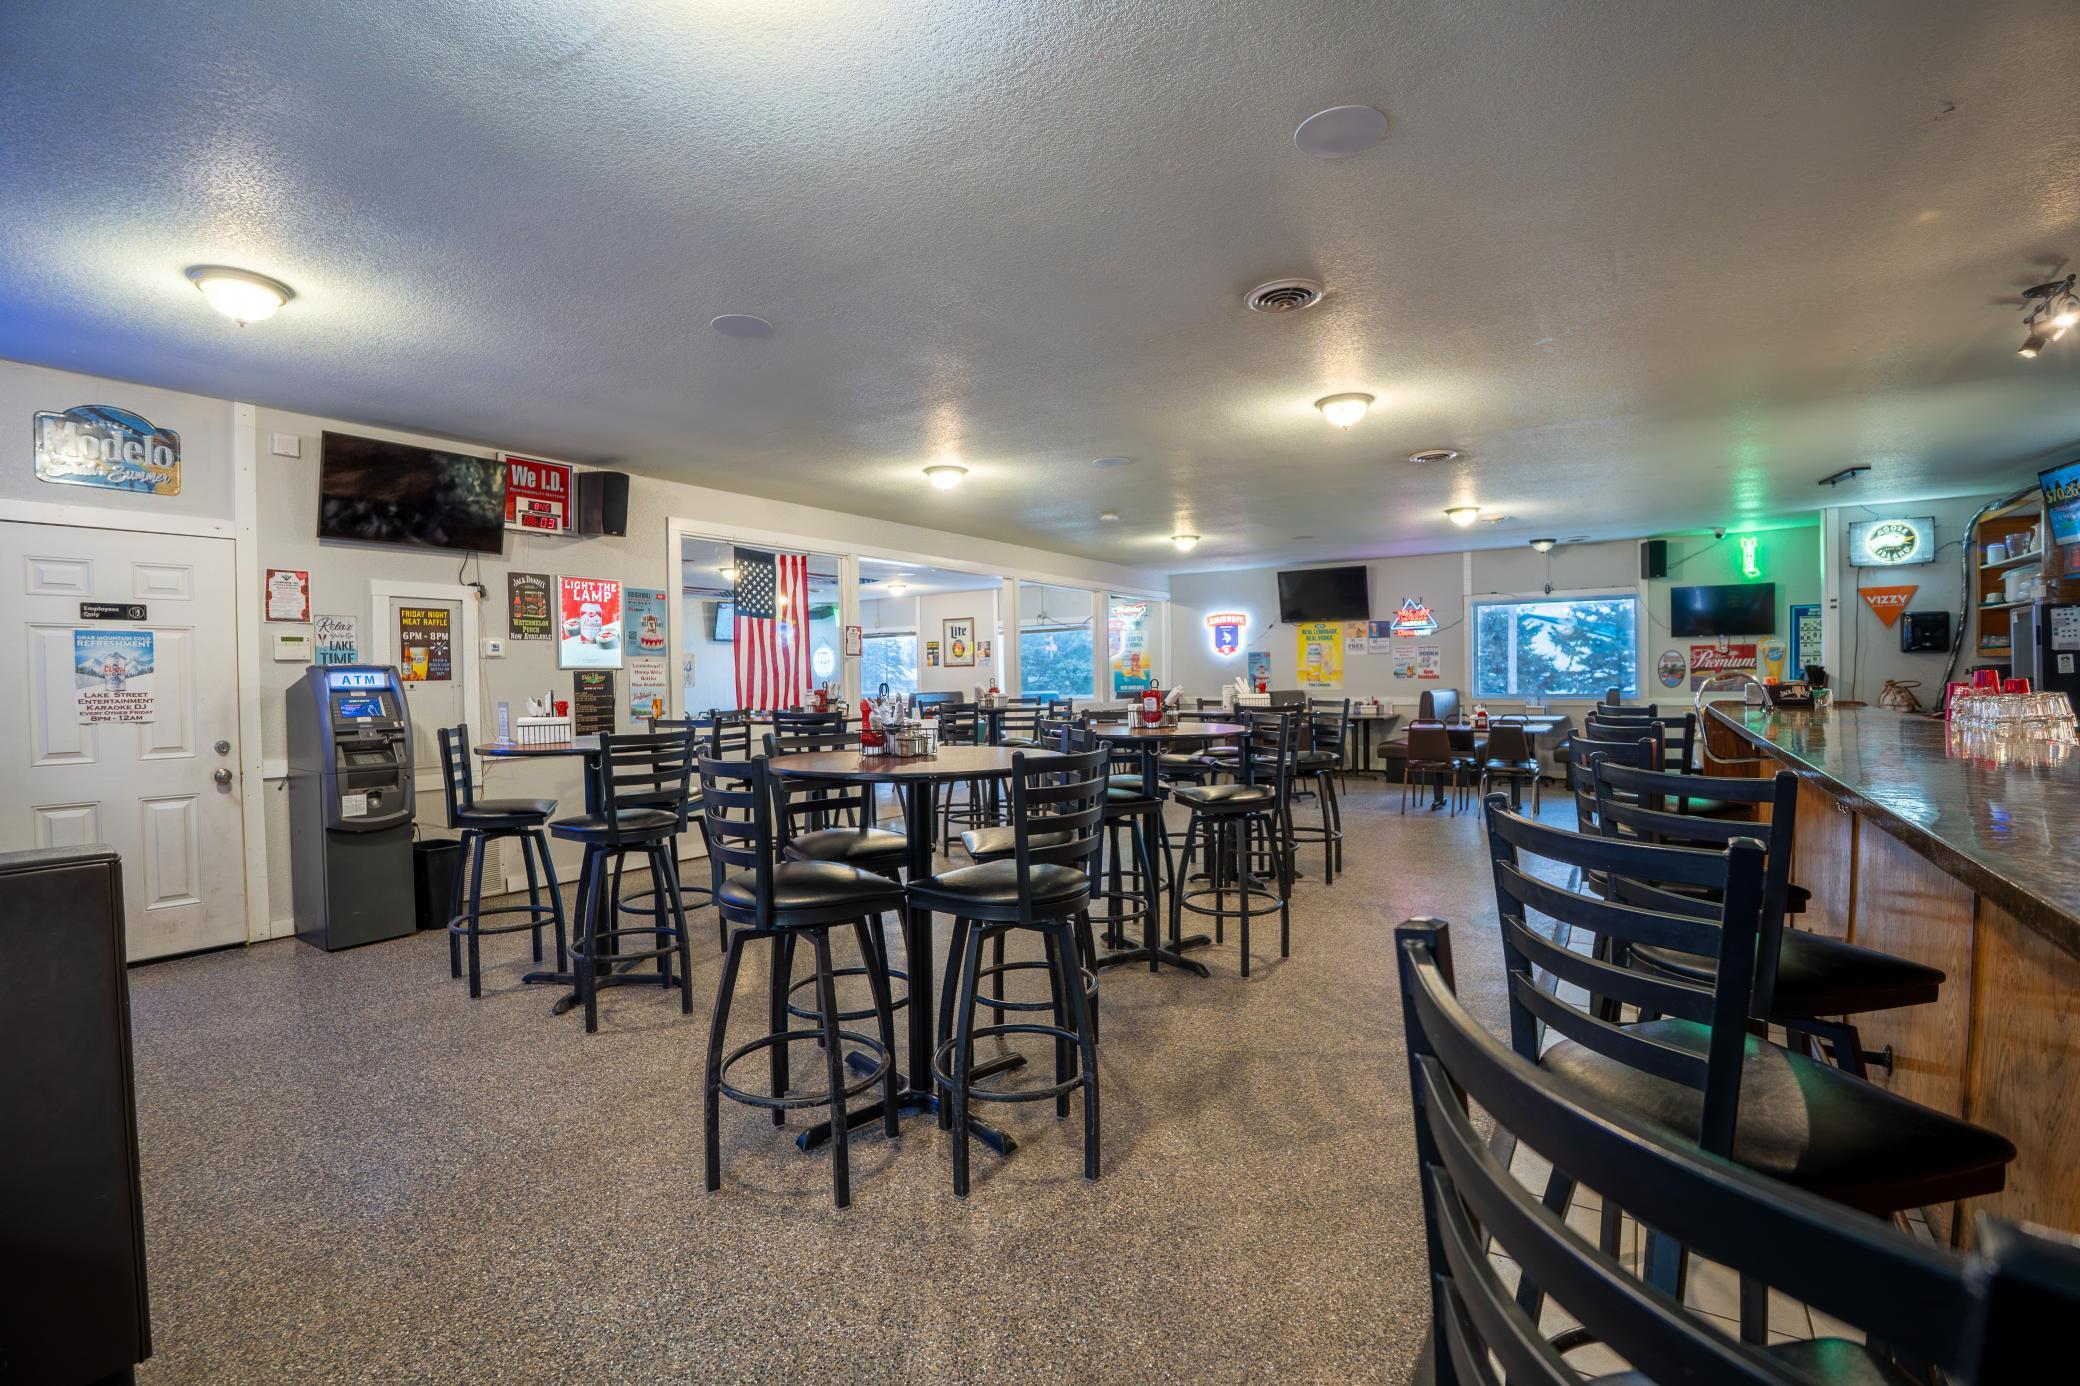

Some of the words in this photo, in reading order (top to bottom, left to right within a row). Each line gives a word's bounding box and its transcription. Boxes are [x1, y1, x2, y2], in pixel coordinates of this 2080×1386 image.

[42, 417, 175, 468] Modelo
[107, 465, 172, 485] Summer
[511, 464, 537, 488] We
[541, 469, 564, 493] I.D.
[1877, 525, 1909, 535] GOOSE
[1877, 546, 1910, 559] ISLAND
[564, 580, 595, 590] LIGHT
[597, 582, 617, 593] THE
[573, 589, 612, 603] LAMP
[1866, 594, 1908, 604] VIZZY
[83, 605, 119, 613] Employees
[401, 610, 425, 618] FRIDAY
[427, 611, 448, 619] NIGHT
[316, 617, 353, 633] Relax
[402, 618, 421, 626] MEAT
[423, 618, 448, 626] RAFFLE
[402, 631, 422, 640] 6PM
[430, 632, 449, 641] 8PM
[951, 626, 967, 639] Lite
[76, 640, 153, 648] REFRESHMENT
[329, 640, 355, 651] LAKE
[320, 652, 355, 664] TIME
[1690, 649, 1757, 669] Premium
[342, 675, 375, 685] ATM
